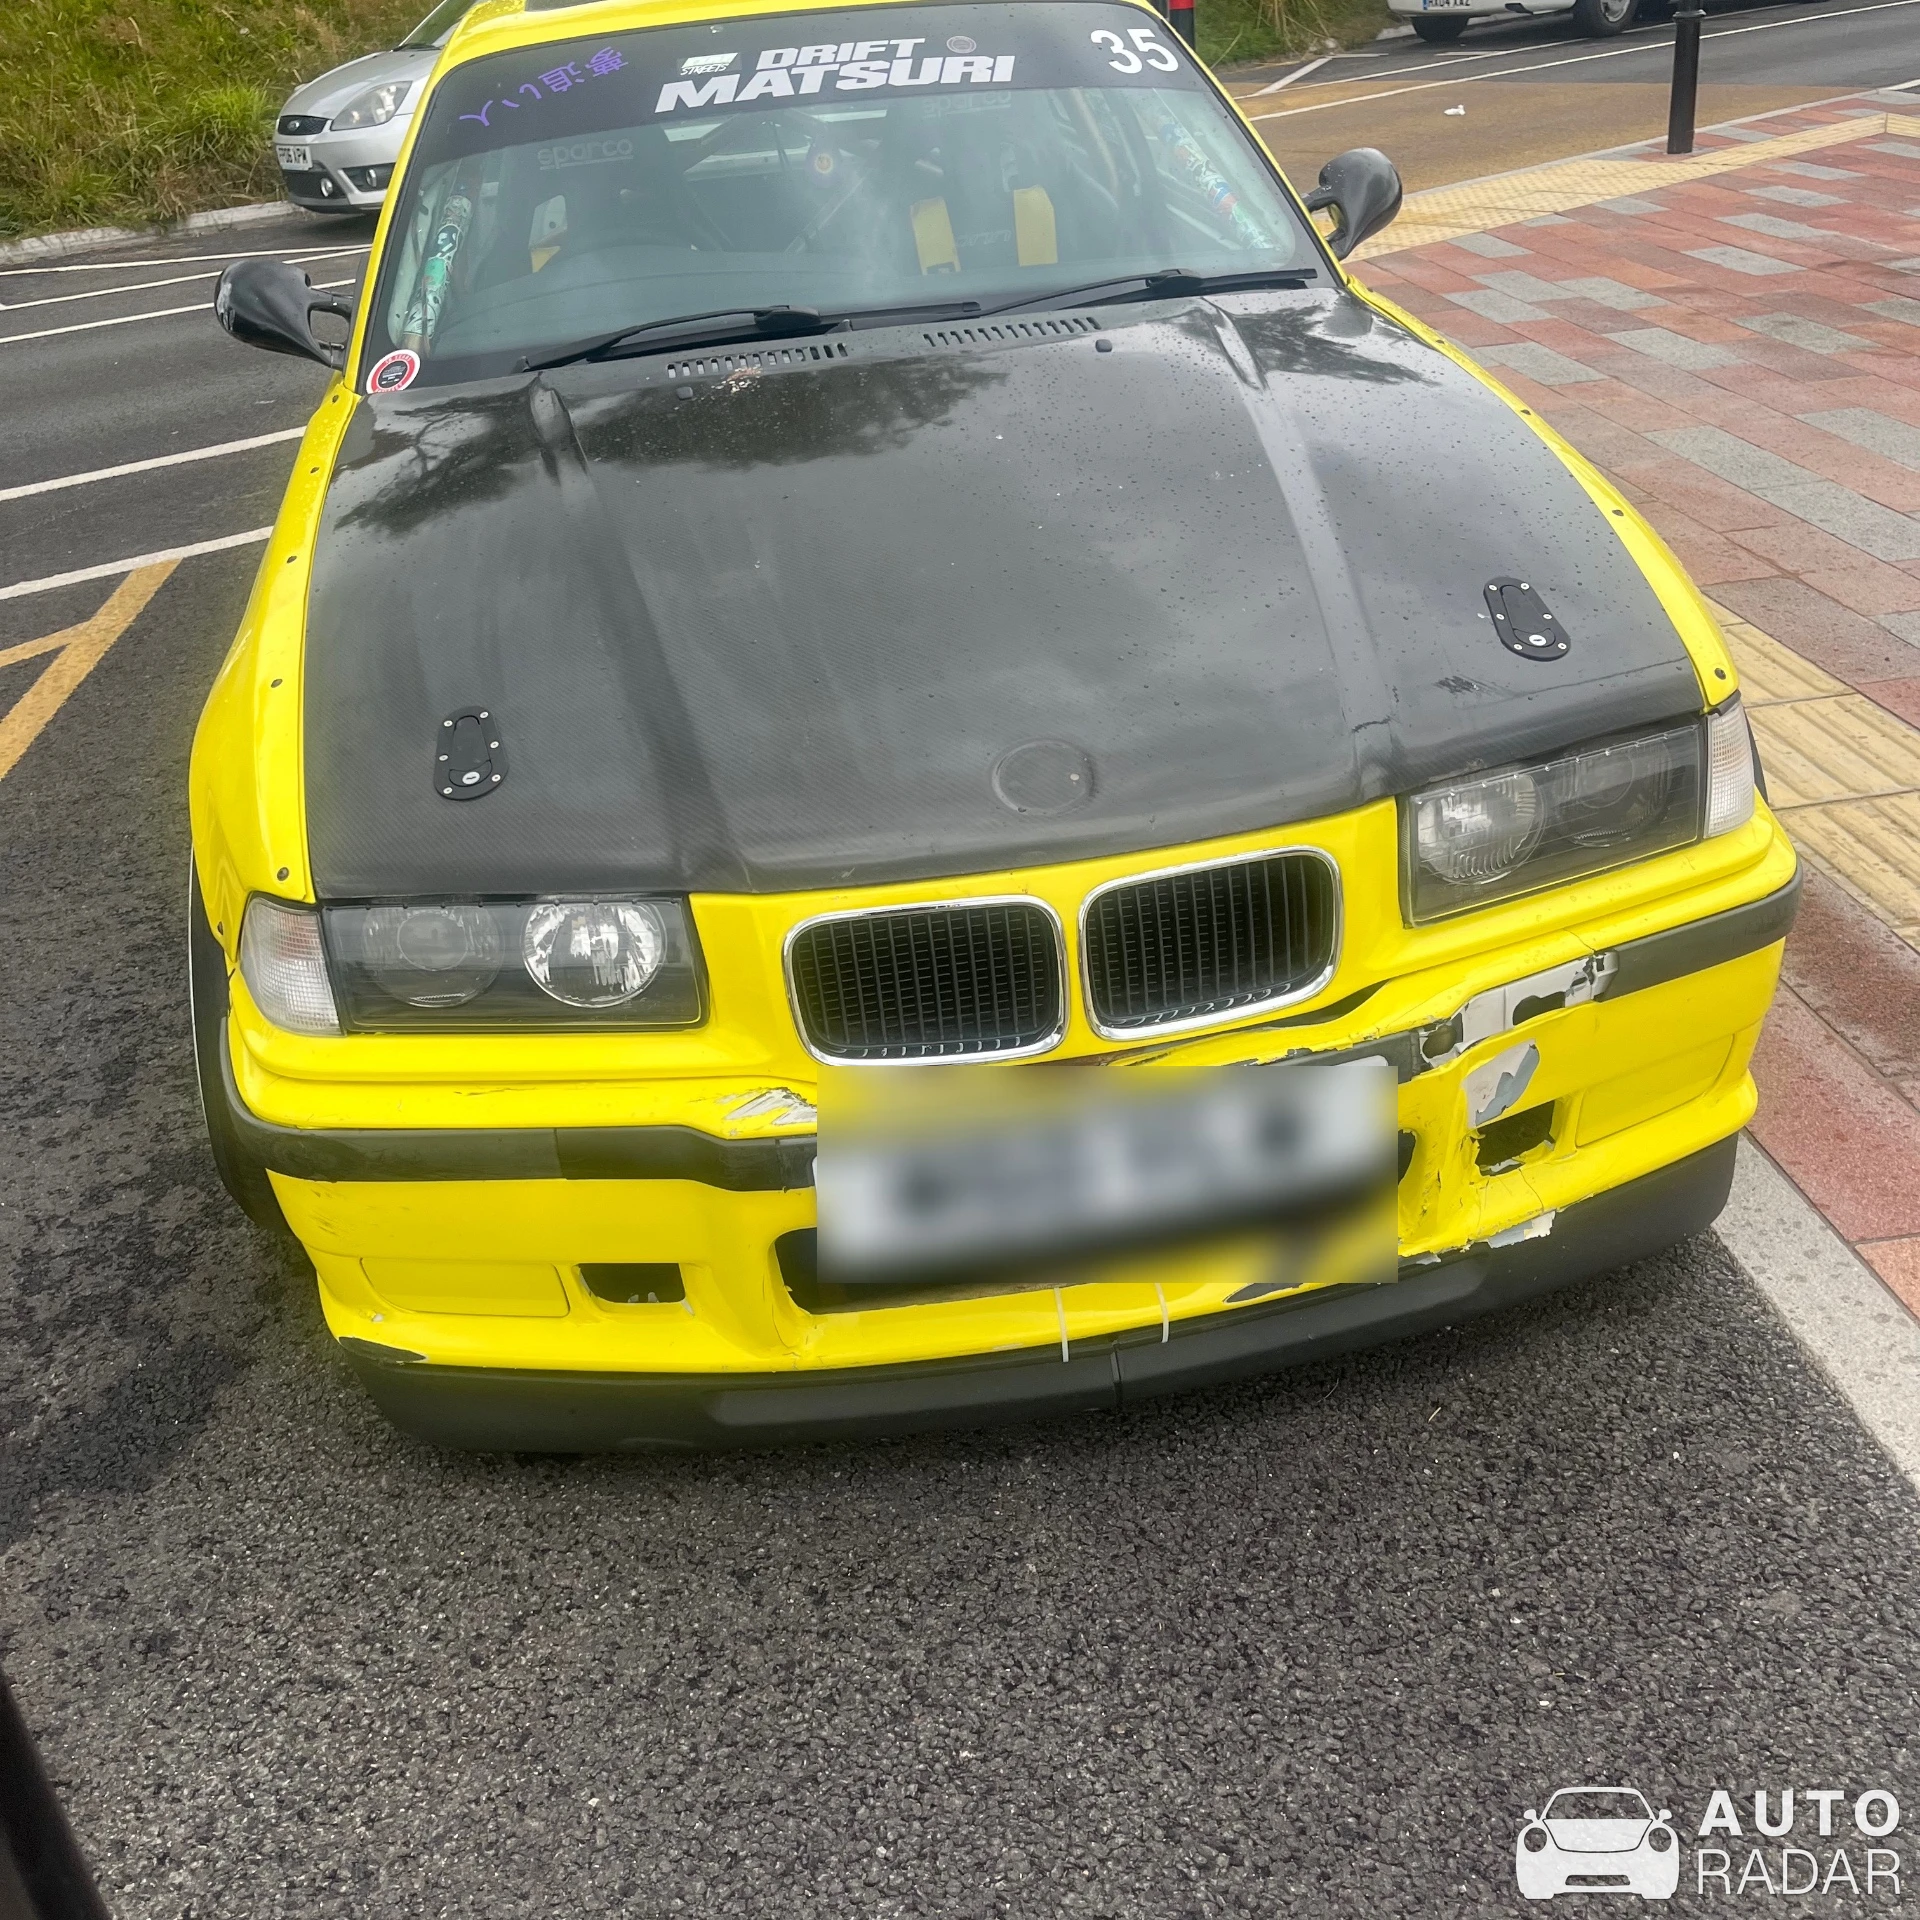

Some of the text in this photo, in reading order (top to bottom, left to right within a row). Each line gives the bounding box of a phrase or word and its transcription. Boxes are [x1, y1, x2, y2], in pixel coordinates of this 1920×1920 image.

[756, 38, 926, 71] DRIFT
[1090, 28, 1179, 74] 35
[654, 55, 1015, 113] MATSURI
[680, 63, 729, 76] STREETS
[537, 138, 634, 170] sparco
